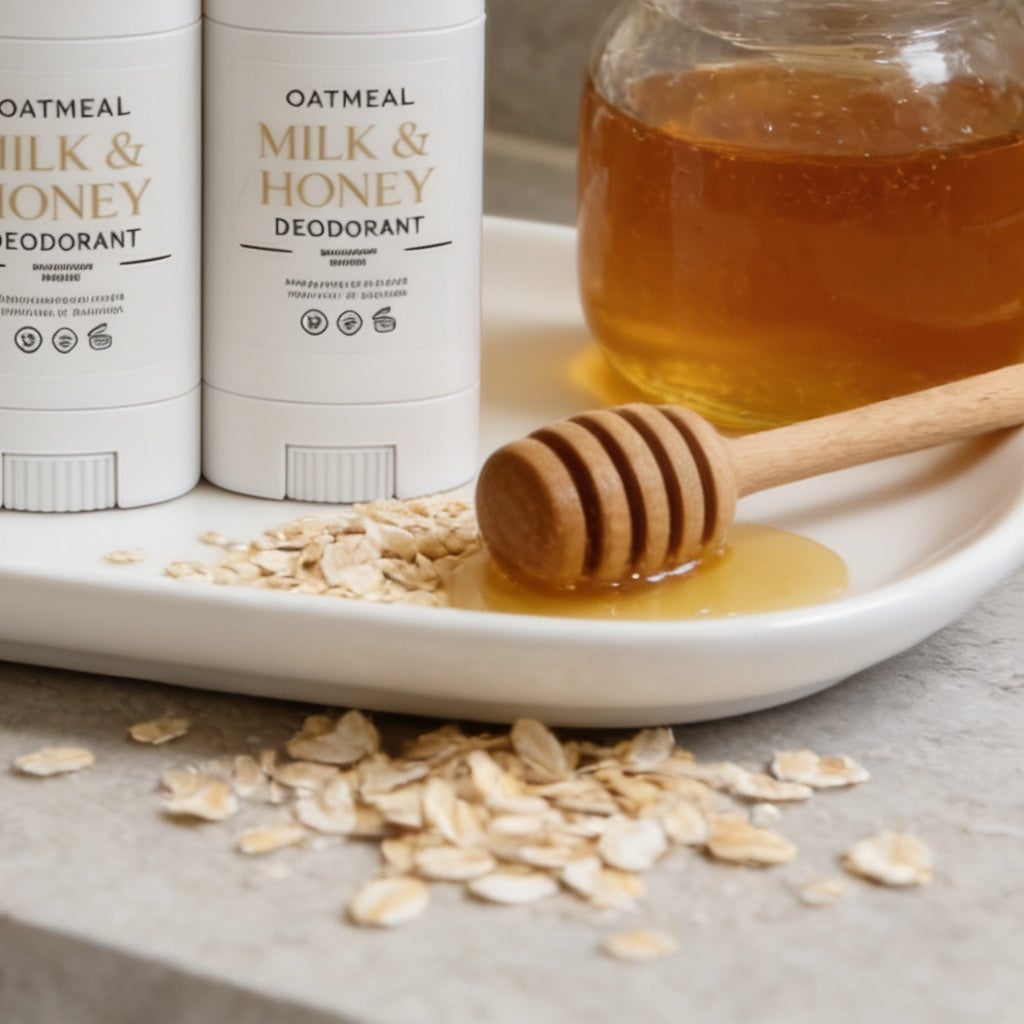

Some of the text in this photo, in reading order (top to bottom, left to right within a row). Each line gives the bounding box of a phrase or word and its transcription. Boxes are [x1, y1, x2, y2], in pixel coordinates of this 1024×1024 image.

[286, 88, 415, 108] OATMEAL
[105, 131, 145, 169] &
[258, 121, 429, 161] MILK &
[259, 167, 435, 208] HONEY
[275, 216, 425, 237] DEODORANT
